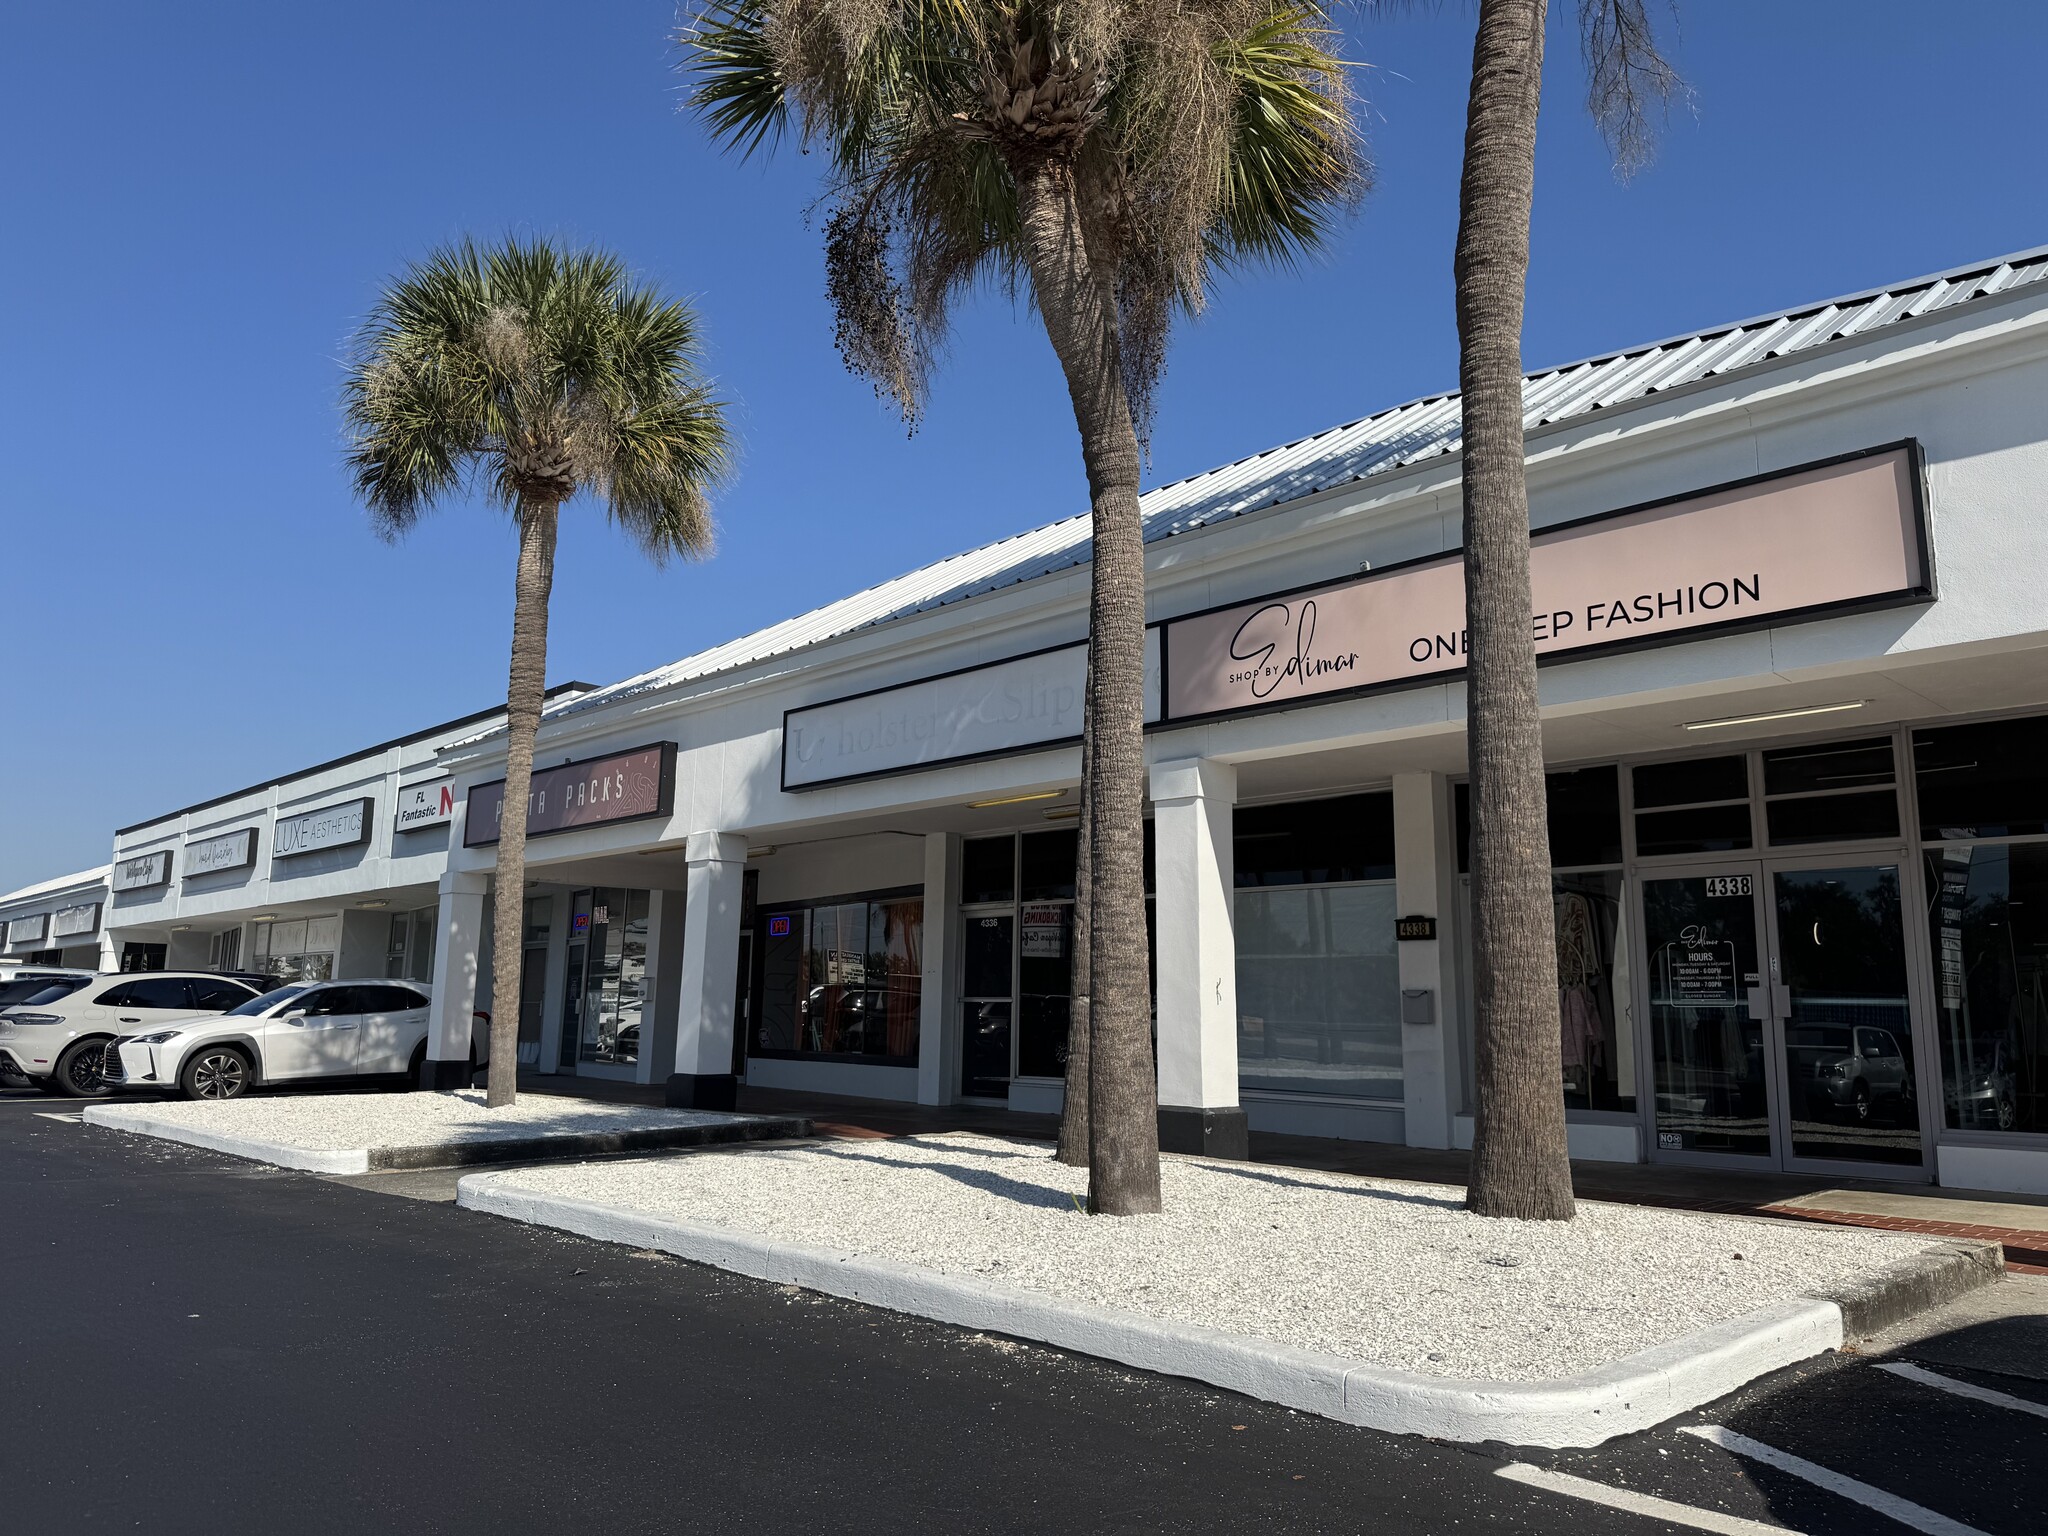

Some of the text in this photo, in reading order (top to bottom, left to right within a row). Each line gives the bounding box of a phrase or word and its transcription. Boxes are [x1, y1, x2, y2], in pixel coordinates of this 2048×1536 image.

[1533, 611, 1574, 641] EP
[1587, 574, 1760, 632] FASHION
[1229, 600, 1360, 698] SHOP BY Edimar
[416, 791, 425, 804] FL
[495, 773, 624, 823] PTA PACKS
[401, 805, 437, 823] Fantastic
[275, 812, 363, 854] LUXE AESTHETICS
[1707, 877, 1750, 896] 4338
[980, 918, 998, 928] 4336
[1402, 922, 1427, 935] 4338
[1688, 952, 1714, 962] HOURS
[1660, 1134, 1673, 1143] NO
